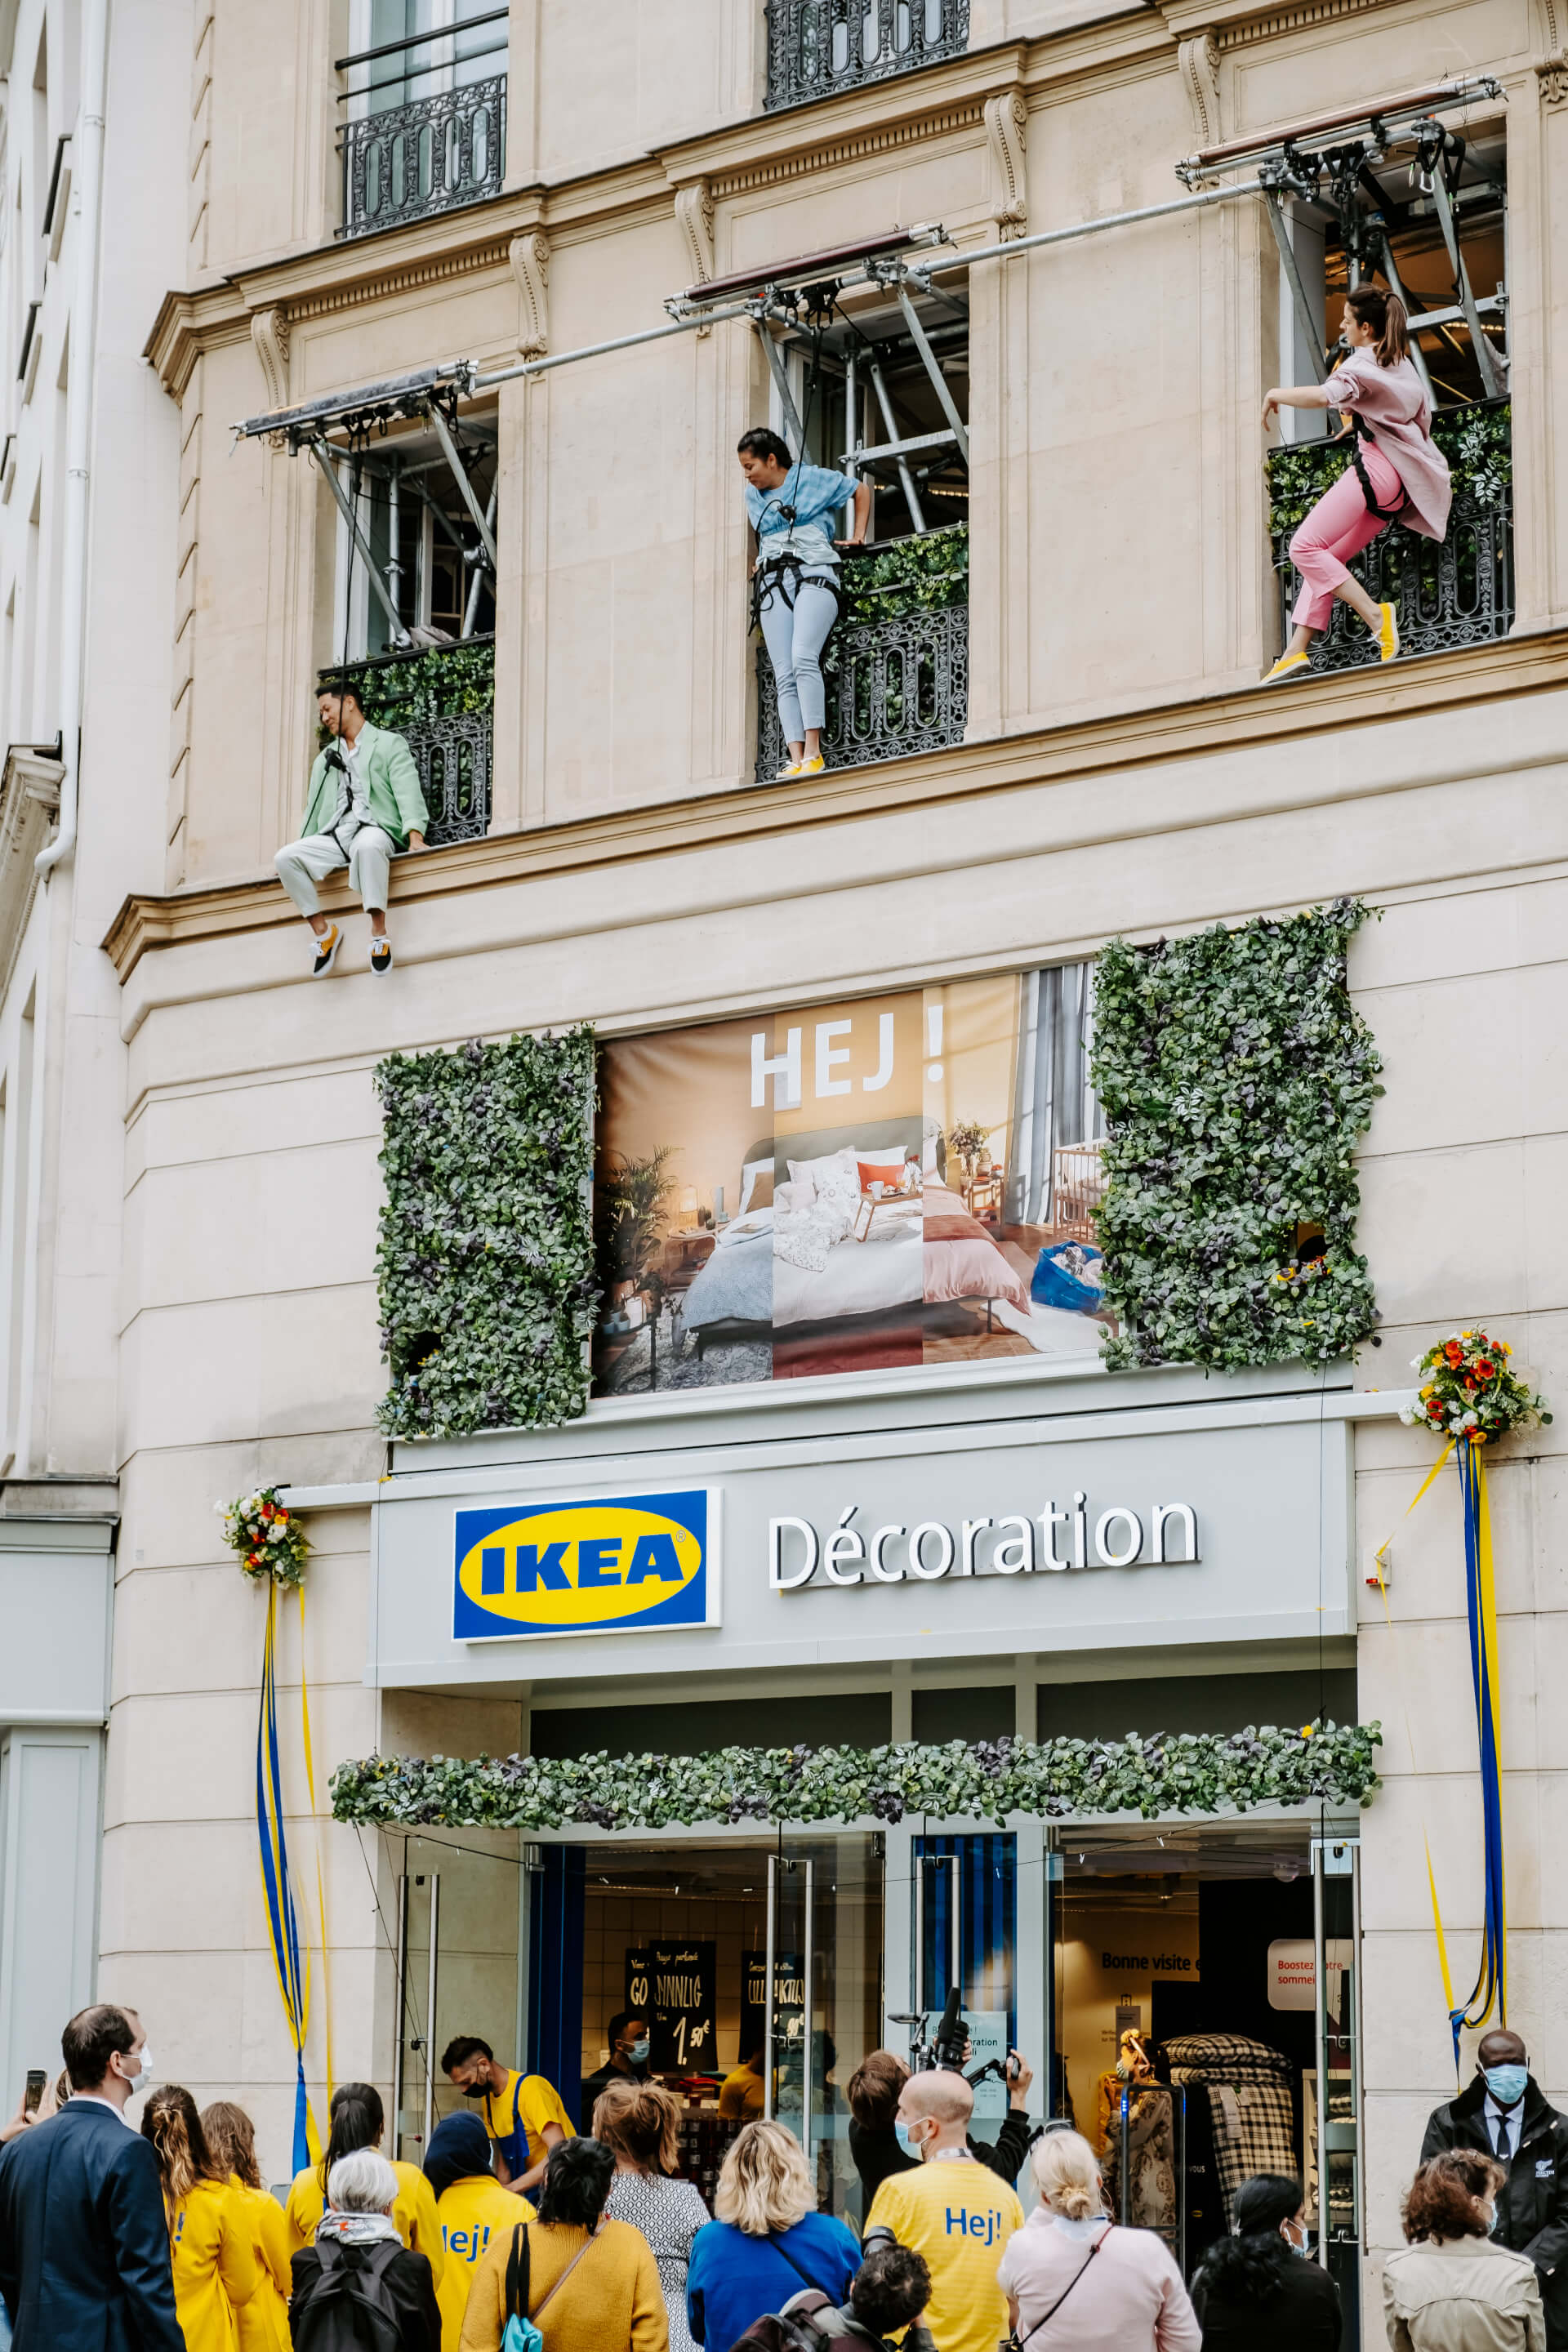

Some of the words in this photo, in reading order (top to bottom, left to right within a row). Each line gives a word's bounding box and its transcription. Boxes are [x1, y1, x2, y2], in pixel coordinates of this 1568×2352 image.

[751, 1012, 894, 1108] HEJ
[769, 1490, 1203, 1589] Décoration
[1102, 1953, 1149, 1970] Bonne
[1152, 1953, 1192, 1971] visite
[1278, 1960, 1314, 1970] Boostez
[630, 1976, 648, 2007] GO
[1278, 1976, 1316, 1984] sommei
[442, 2223, 490, 2262] ej!
[946, 2207, 1001, 2247] Hej!
